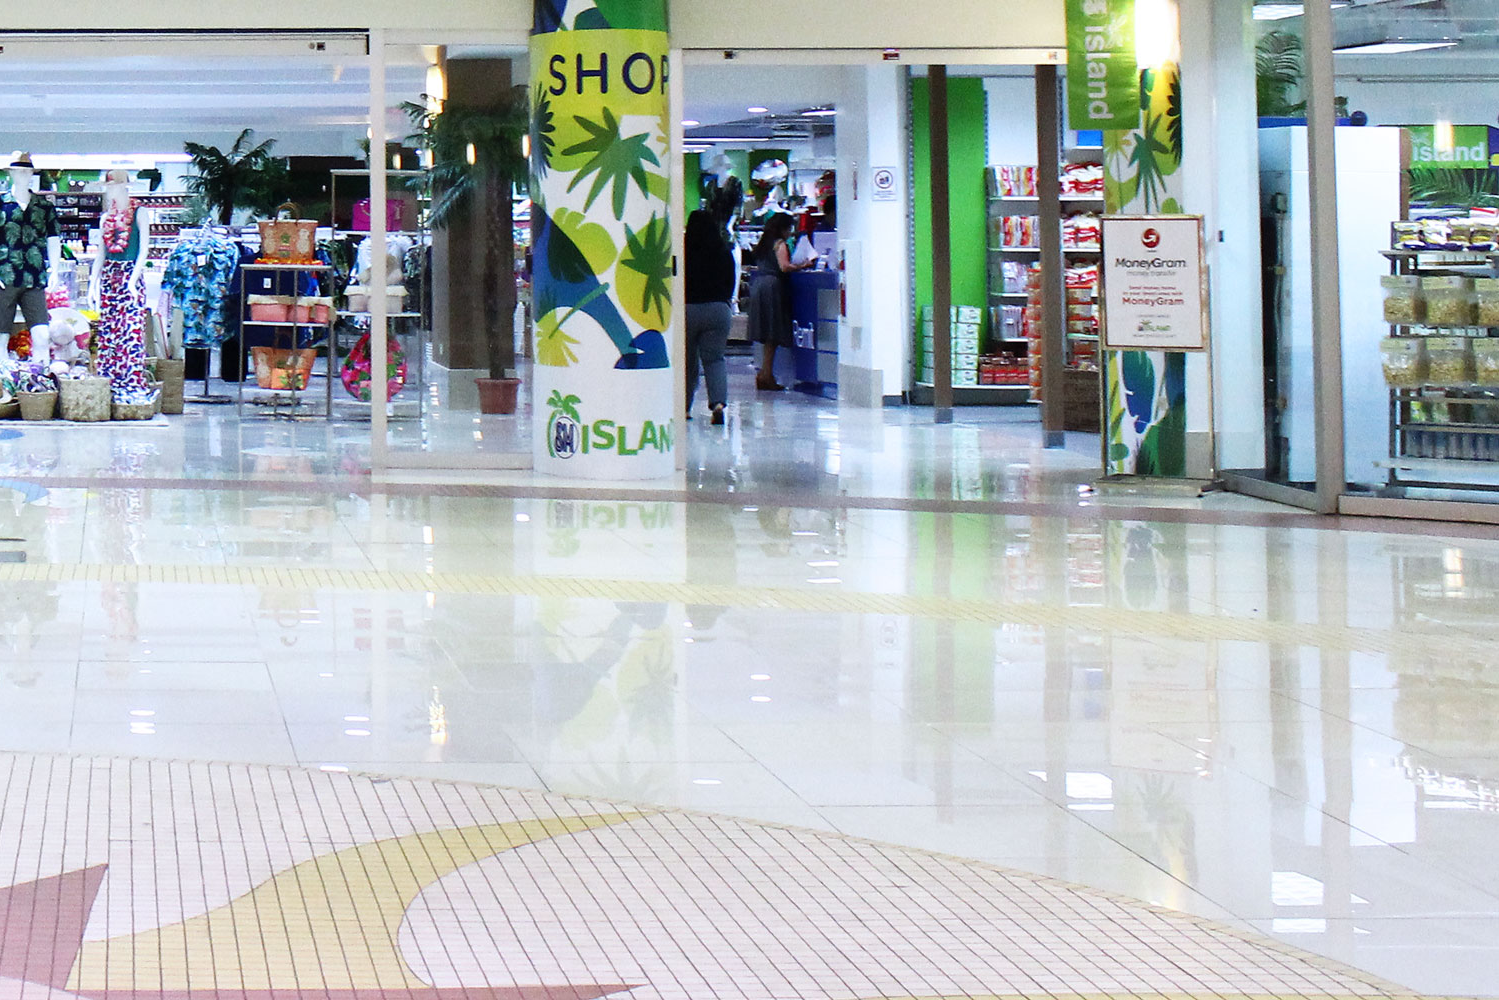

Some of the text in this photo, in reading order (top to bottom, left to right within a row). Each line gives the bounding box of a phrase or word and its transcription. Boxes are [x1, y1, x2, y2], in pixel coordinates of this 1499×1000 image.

[1085, 25, 1115, 120] island
[1412, 141, 1487, 162] island
[1114, 257, 1187, 271] MoneyGram
[1122, 297, 1185, 307] MoneyGram
[581, 418, 674, 456] ISLAN
